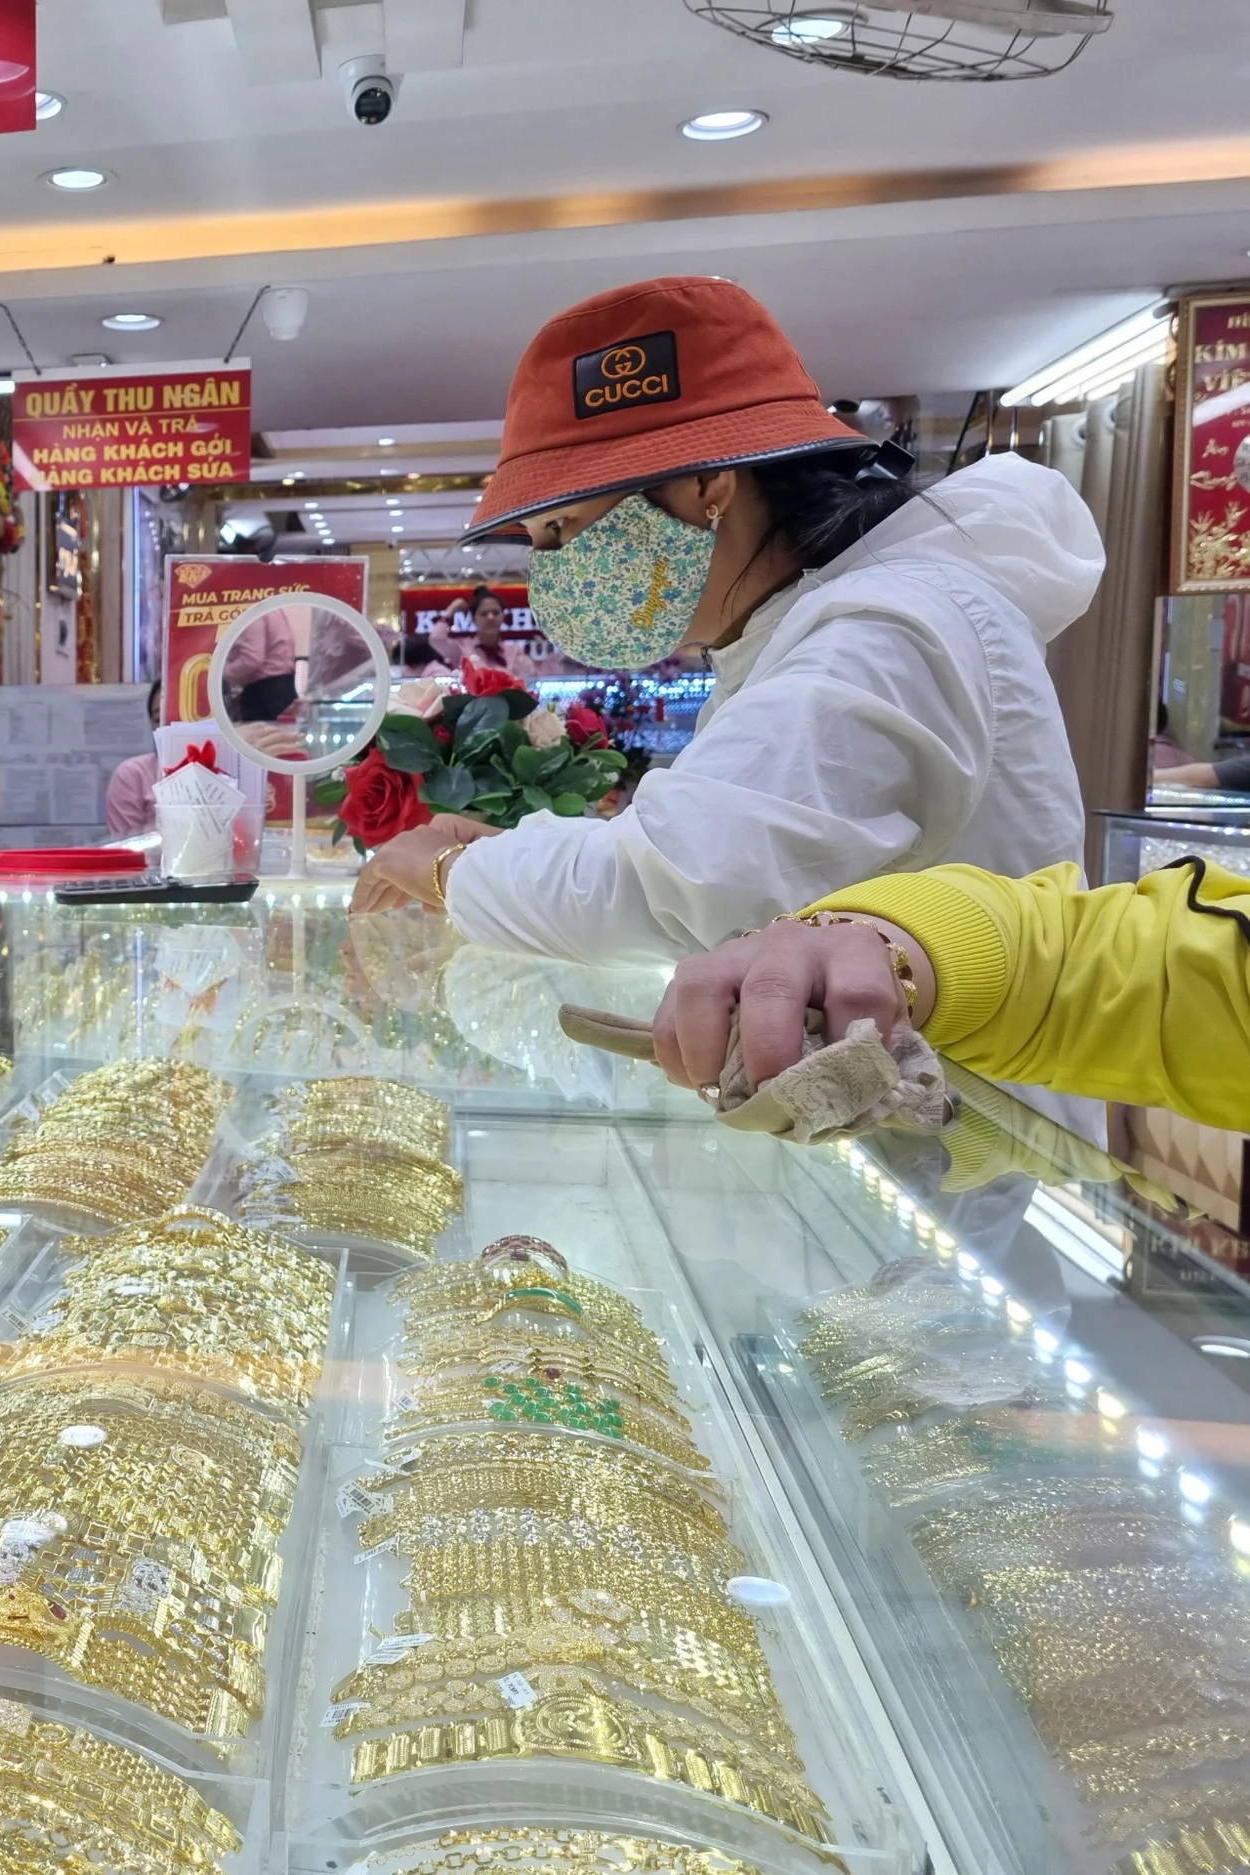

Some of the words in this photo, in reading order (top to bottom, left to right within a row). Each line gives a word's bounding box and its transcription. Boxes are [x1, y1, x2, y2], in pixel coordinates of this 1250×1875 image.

[25, 382, 96, 419] QUẦY
[103, 386, 154, 412] THU
[162, 377, 241, 409] NGÂN
[125, 418, 153, 435] VÀ
[159, 414, 199, 434] TRẢ
[33, 442, 96, 465] HÀNG
[104, 438, 184, 461] KHÁCH
[30, 465, 94, 486] HÀNG
[101, 462, 181, 483] KHÁCH
[187, 457, 234, 479] SỬA
[182, 591, 218, 606] MUA
[221, 587, 275, 603] TRANG
[184, 608, 214, 624] TRẢ
[218, 605, 248, 622] GÓ
